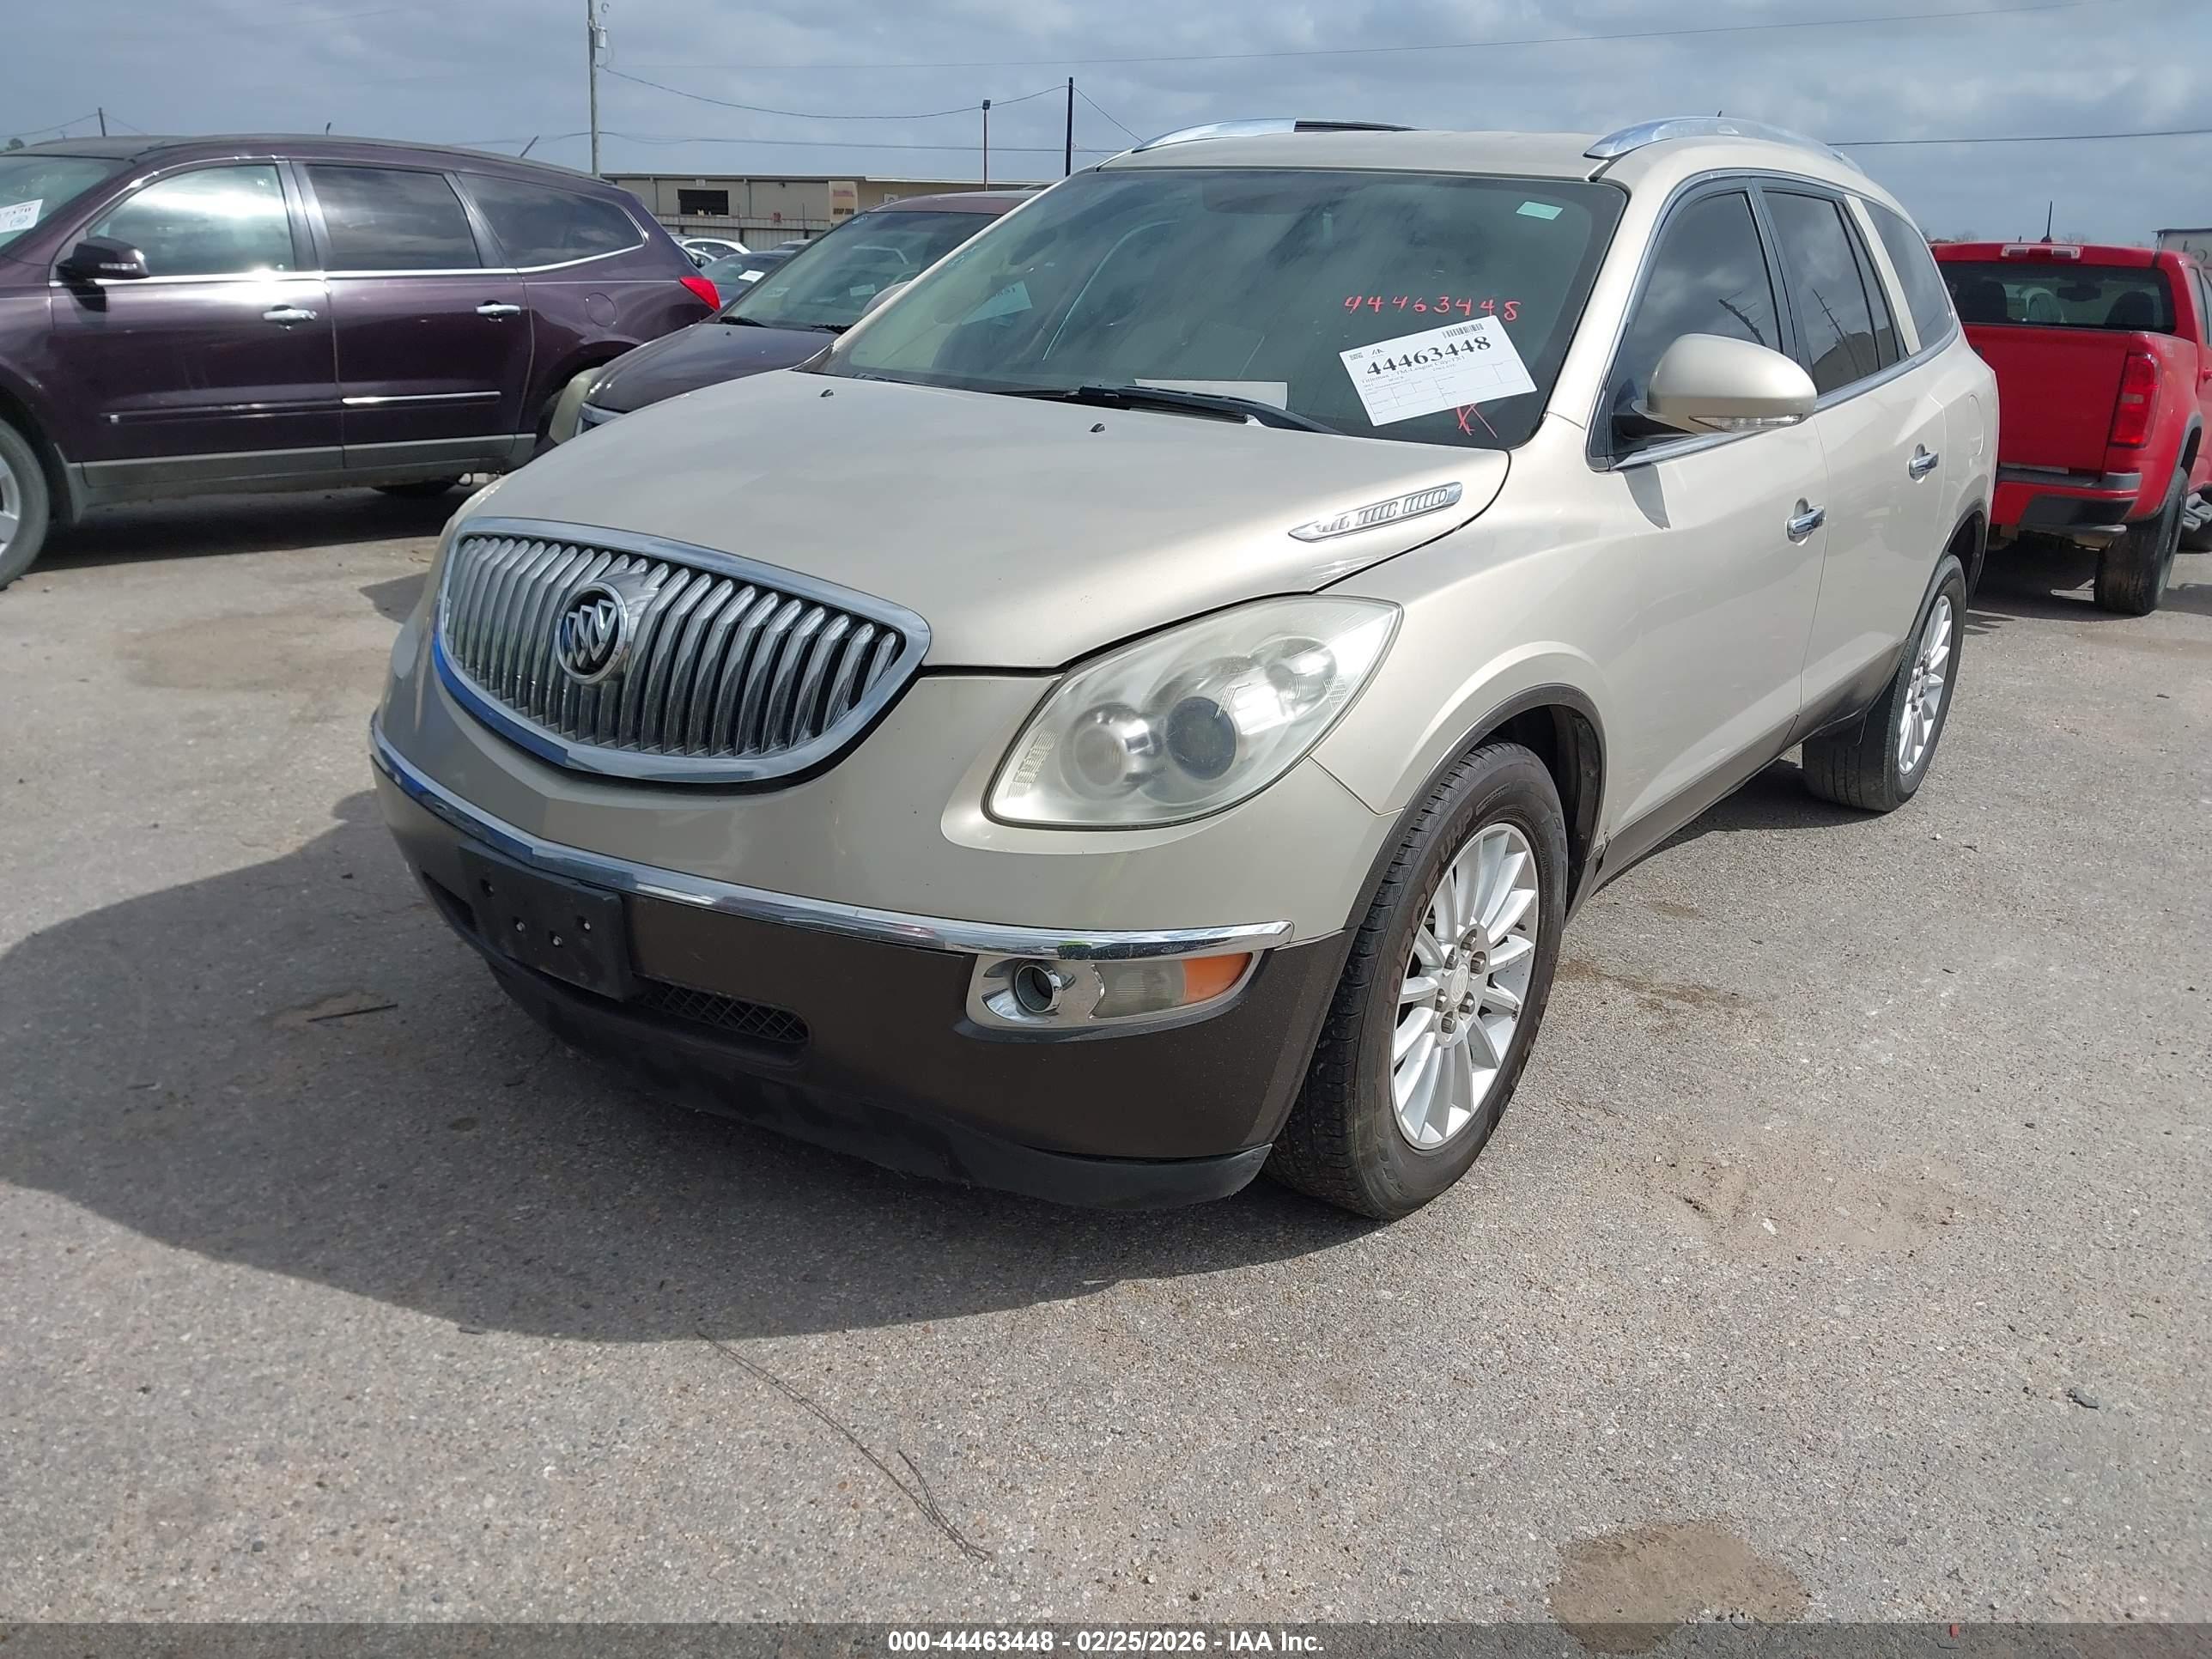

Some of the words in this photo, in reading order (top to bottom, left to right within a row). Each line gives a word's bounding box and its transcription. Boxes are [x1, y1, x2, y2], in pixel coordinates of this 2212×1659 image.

[1344, 295, 1521, 321] 44463448
[1366, 336, 1492, 375] 44463448
[1440, 805, 1474, 858] UHP
